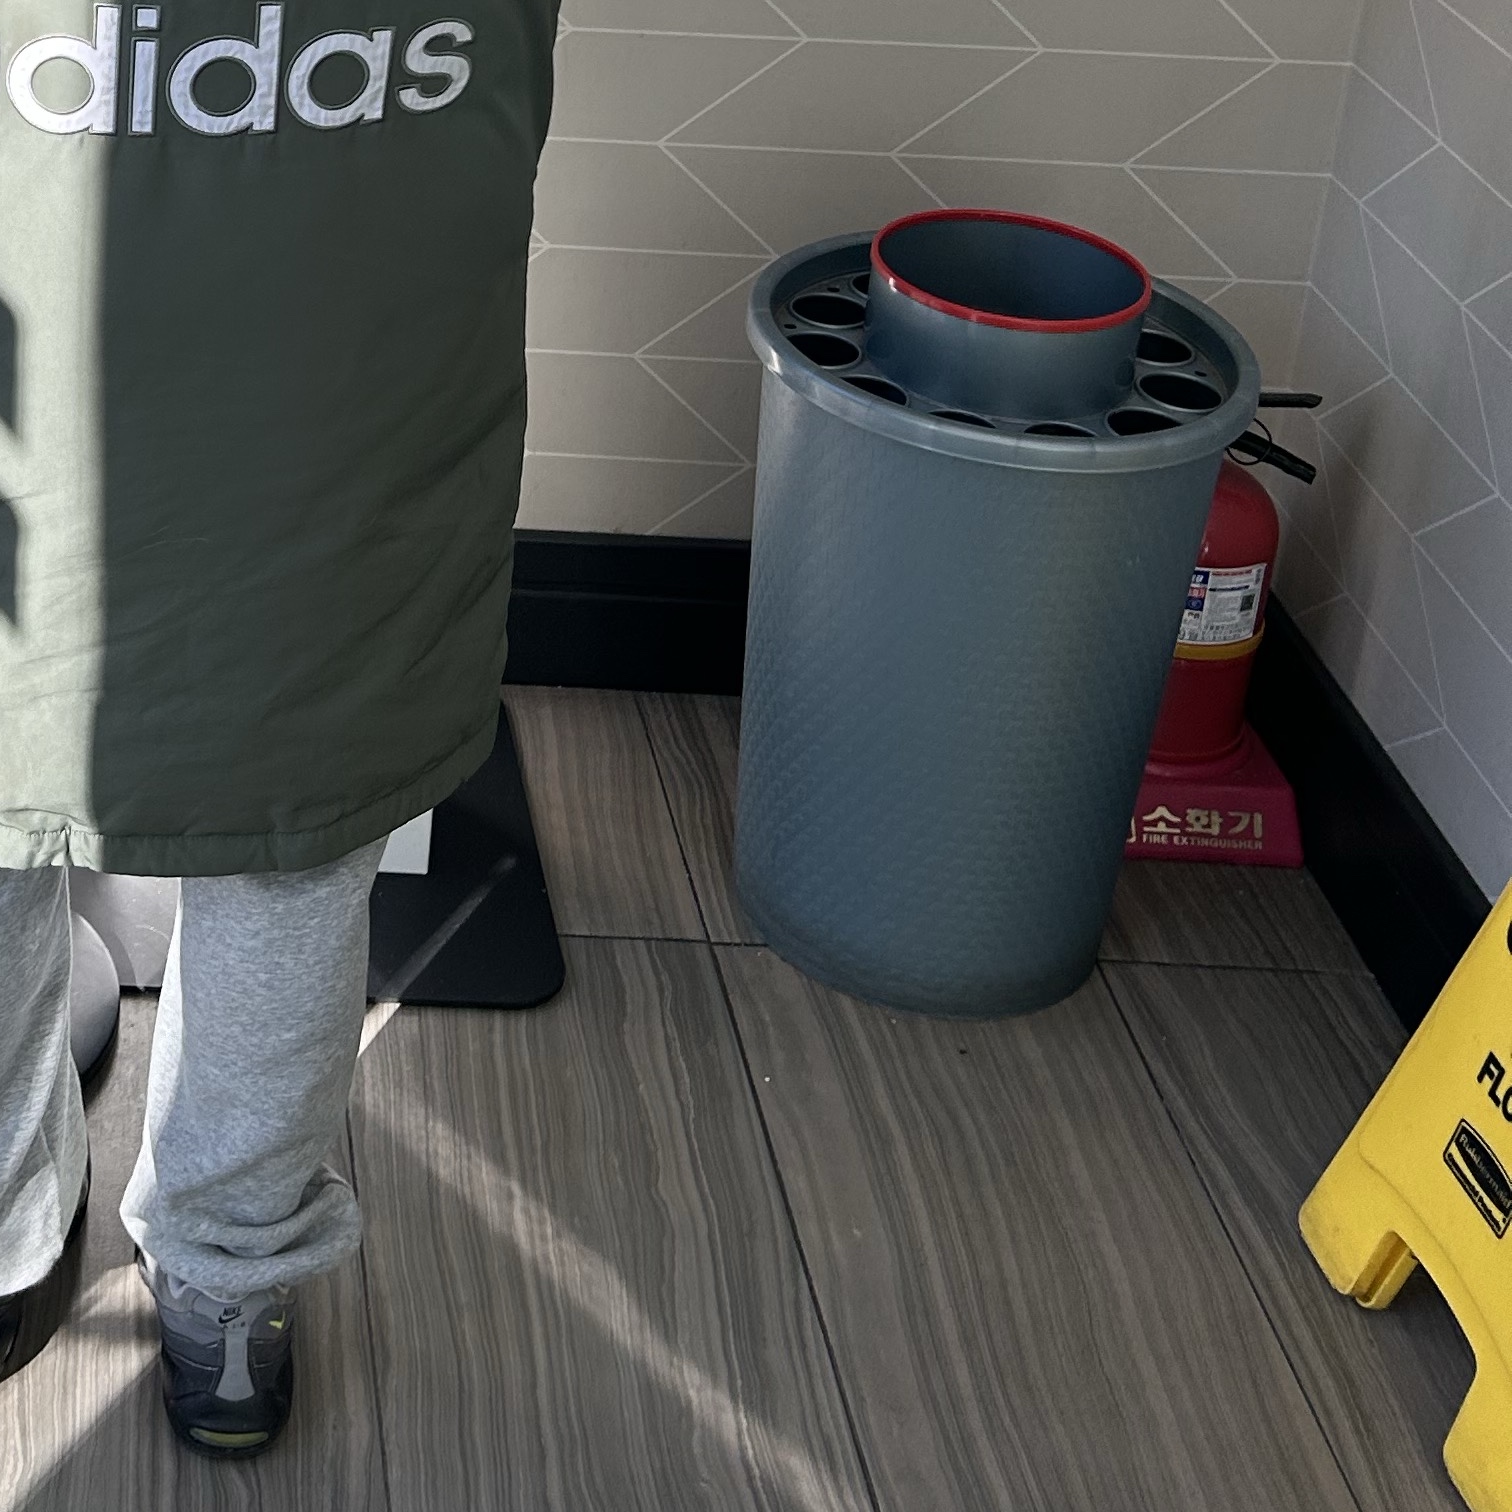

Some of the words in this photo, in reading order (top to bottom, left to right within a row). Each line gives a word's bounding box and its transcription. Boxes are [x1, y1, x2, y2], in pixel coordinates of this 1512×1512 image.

[1142, 805, 1263, 839] 소화기
[1142, 834, 1169, 845] FIRE
[1173, 835, 1263, 851] EXTINGUISHER
[1458, 1133, 1512, 1211] Rubbermaid
